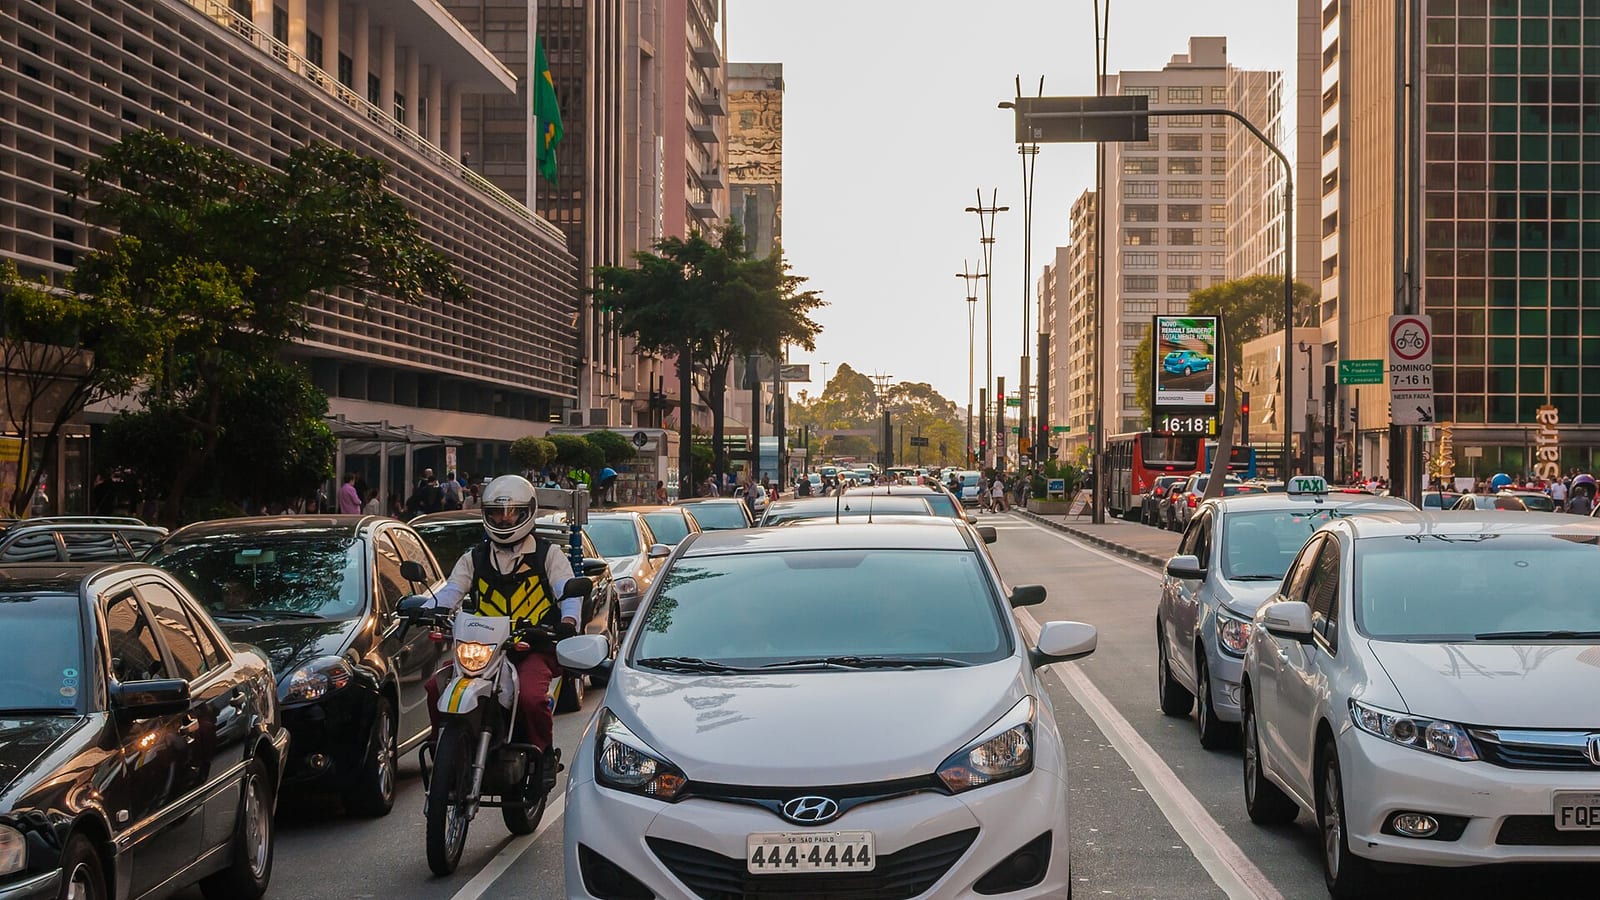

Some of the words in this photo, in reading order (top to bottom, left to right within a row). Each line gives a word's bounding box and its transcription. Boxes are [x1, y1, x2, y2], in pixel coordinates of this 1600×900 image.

[1390, 364, 1432, 372] DOMINGO
[1393, 375, 1419, 385] 7-16
[1423, 375, 1430, 385] h
[1162, 418, 1204, 432] 16:18
[1295, 479, 1324, 491] TAXI
